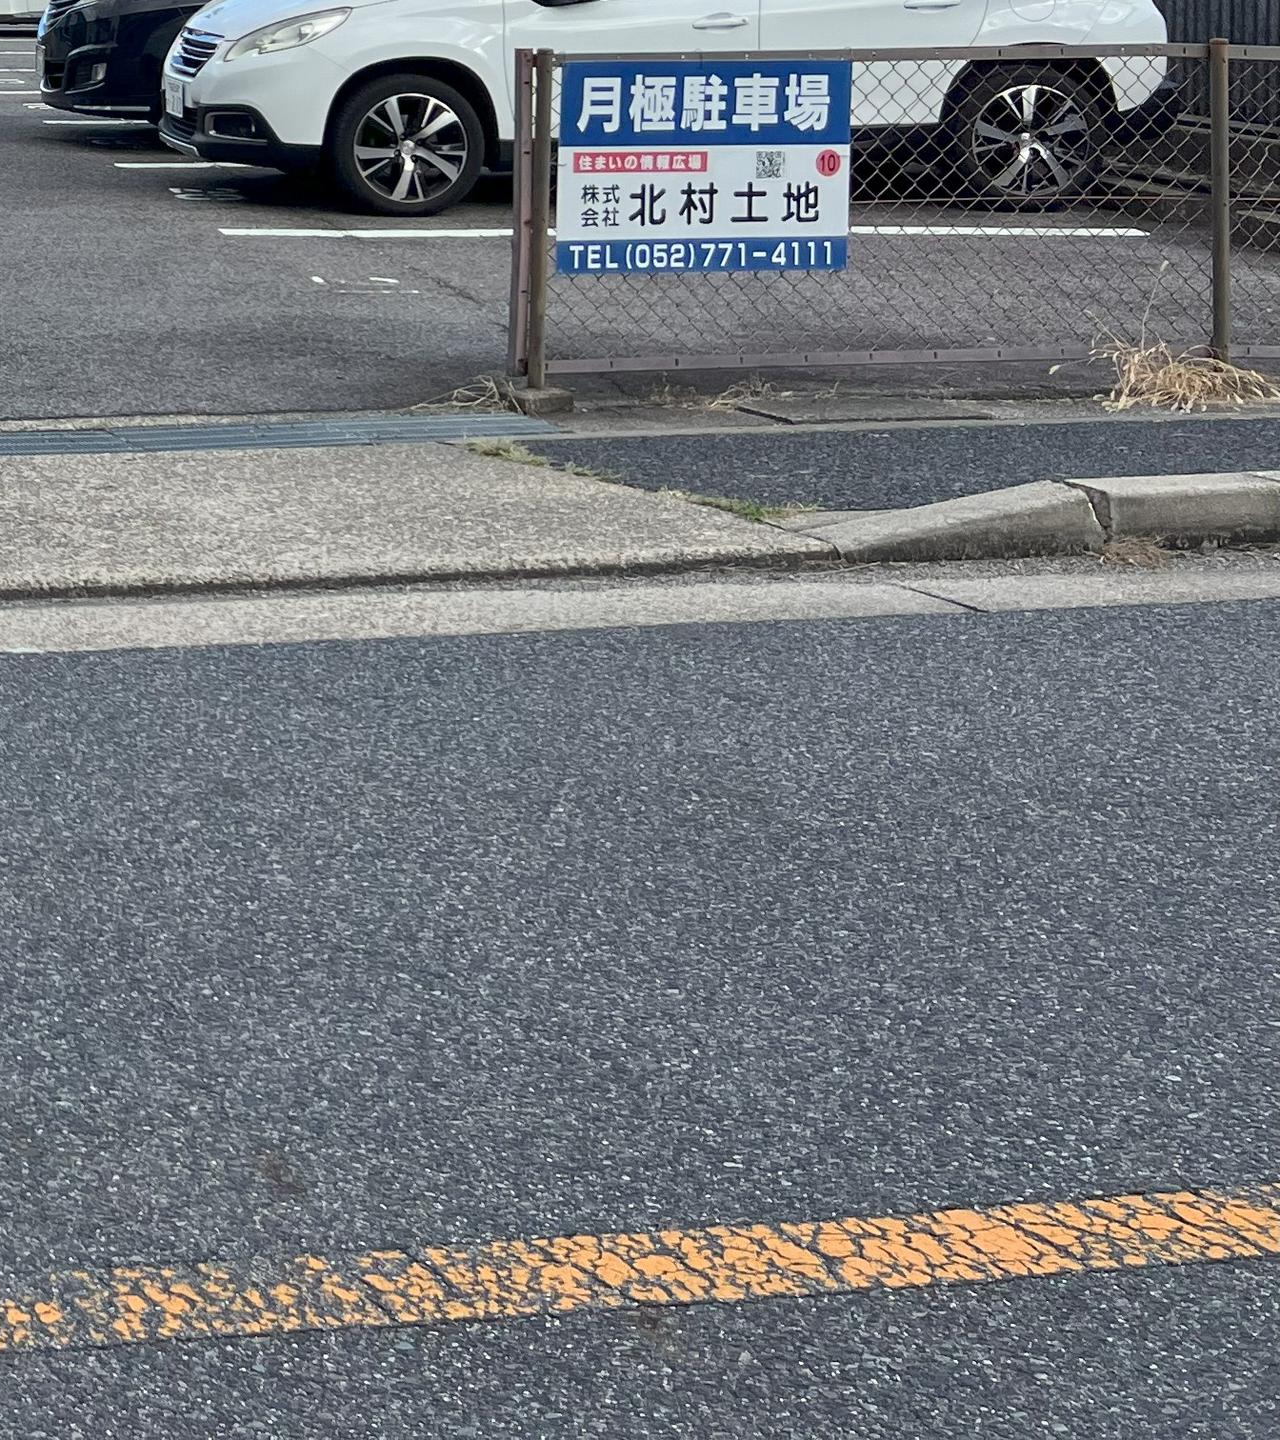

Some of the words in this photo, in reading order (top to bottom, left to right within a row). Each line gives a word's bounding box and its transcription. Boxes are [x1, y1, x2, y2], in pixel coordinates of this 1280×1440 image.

[576, 72, 831, 133] 月極駐車場
[820, 154, 836, 172] 10
[628, 181, 820, 227] 北村土地
